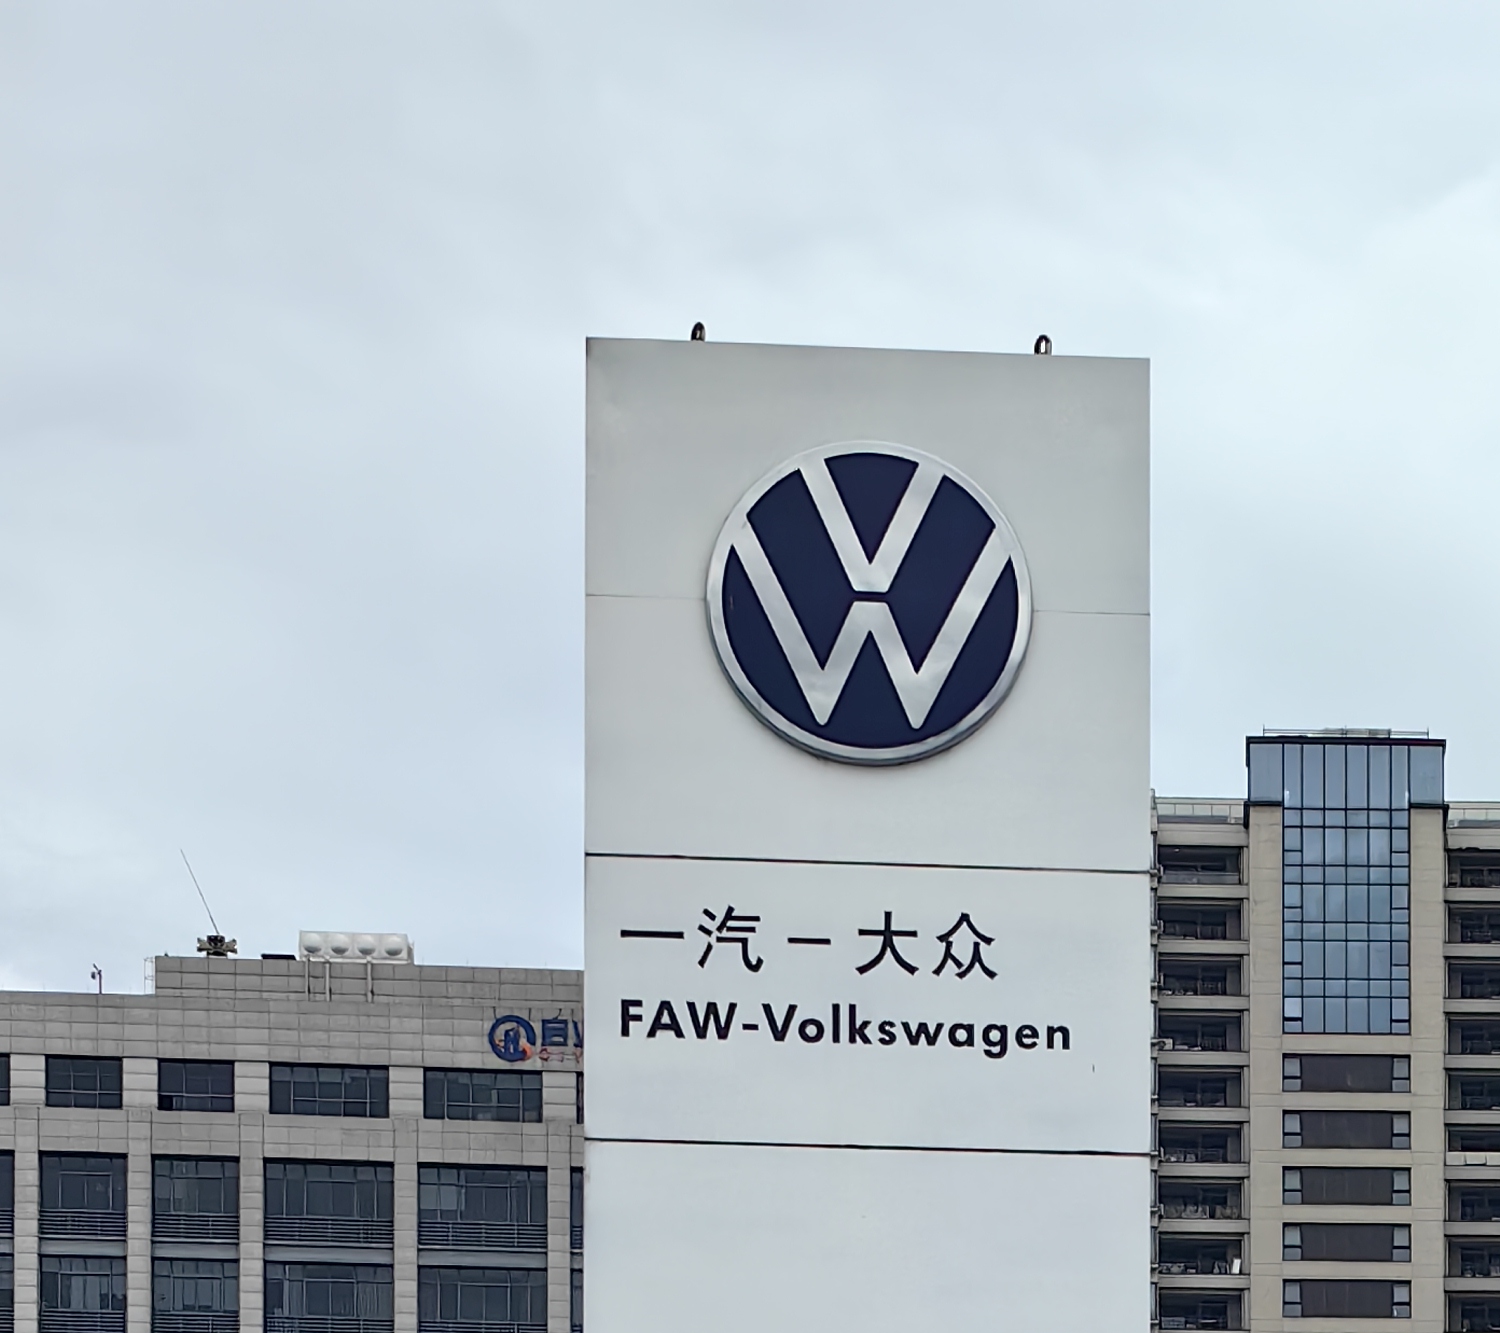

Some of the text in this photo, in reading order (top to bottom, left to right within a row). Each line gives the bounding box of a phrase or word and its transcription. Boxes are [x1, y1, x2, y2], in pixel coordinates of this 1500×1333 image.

[619, 904, 998, 980] 一汽-大众
[619, 997, 1072, 1059] FAW-Volkswagen
